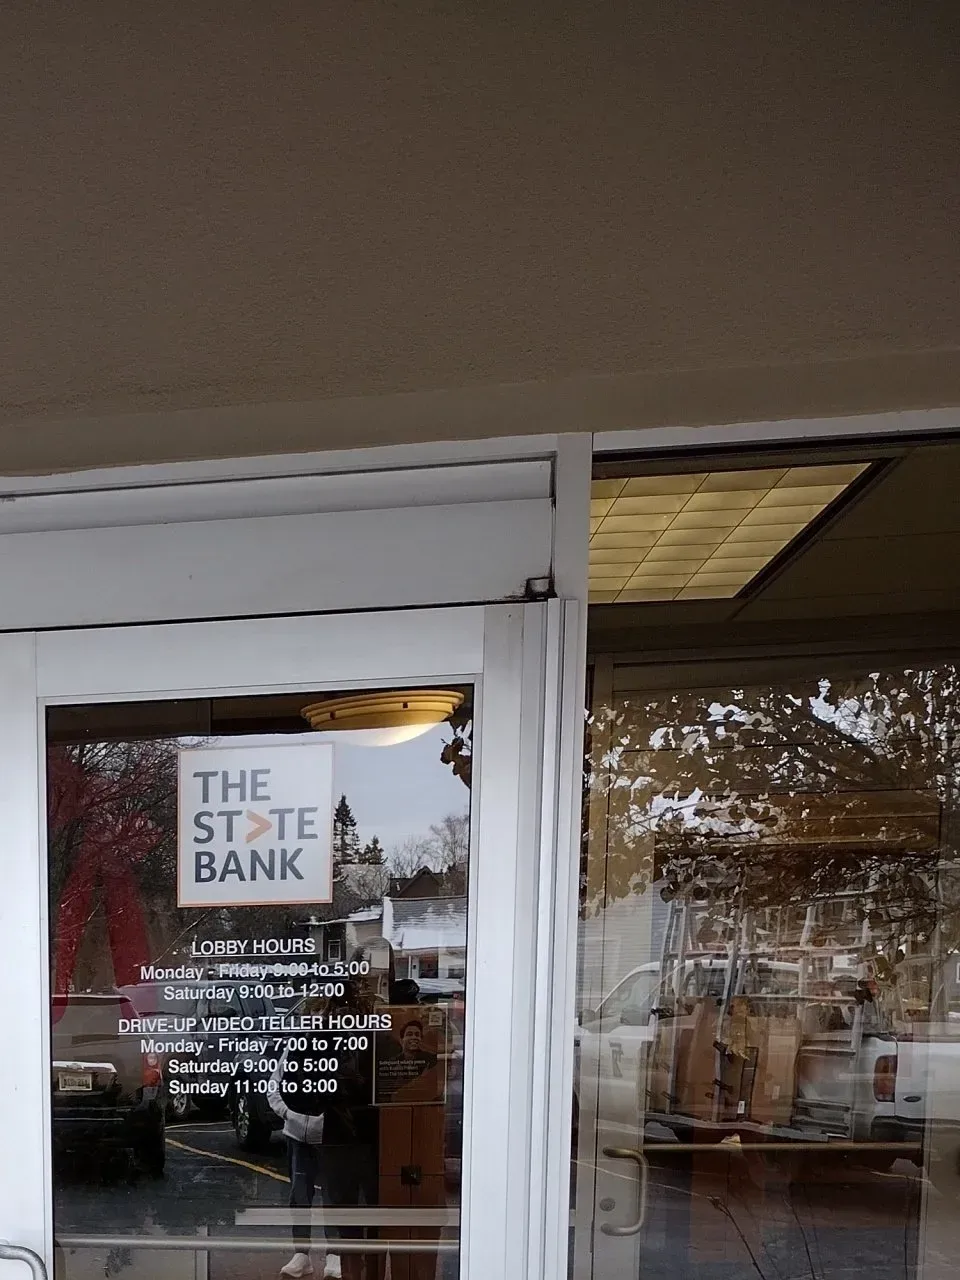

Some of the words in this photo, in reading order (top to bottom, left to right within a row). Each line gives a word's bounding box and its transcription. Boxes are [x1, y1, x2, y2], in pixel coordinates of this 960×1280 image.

[192, 768, 271, 804] THE
[193, 848, 305, 883] BANK
[190, 939, 249, 956] LOBBY
[252, 937, 316, 954] HOURS
[139, 964, 204, 981] Monday
[218, 962, 269, 981] Friday
[313, 962, 330, 976] to
[333, 960, 371, 976] 5:00
[163, 985, 235, 1002] Saturday
[239, 984, 275, 999] 9:00
[278, 985, 295, 998] to
[301, 982, 346, 998] 12:00
[117, 1017, 197, 1033] DRIVE-UP
[202, 1016, 255, 1031] VIDEO
[259, 1015, 324, 1031] TELLER
[328, 1014, 393, 1029] HOURS
[140, 1038, 204, 1055] Monday
[218, 1037, 269, 1054] Friday
[272, 1036, 308, 1052] 7:00
[311, 1037, 329, 1051] to
[332, 1035, 369, 1051] 7:00
[167, 1059, 240, 1077] Saturday
[243, 1058, 279, 1073] 9:00
[282, 1059, 299, 1072] to
[302, 1057, 339, 1072] 5:00
[168, 1079, 230, 1098] Sunday
[234, 1079, 280, 1094] 11:00
[281, 1080, 298, 1093] to
[302, 1078, 338, 1093] 3:00
